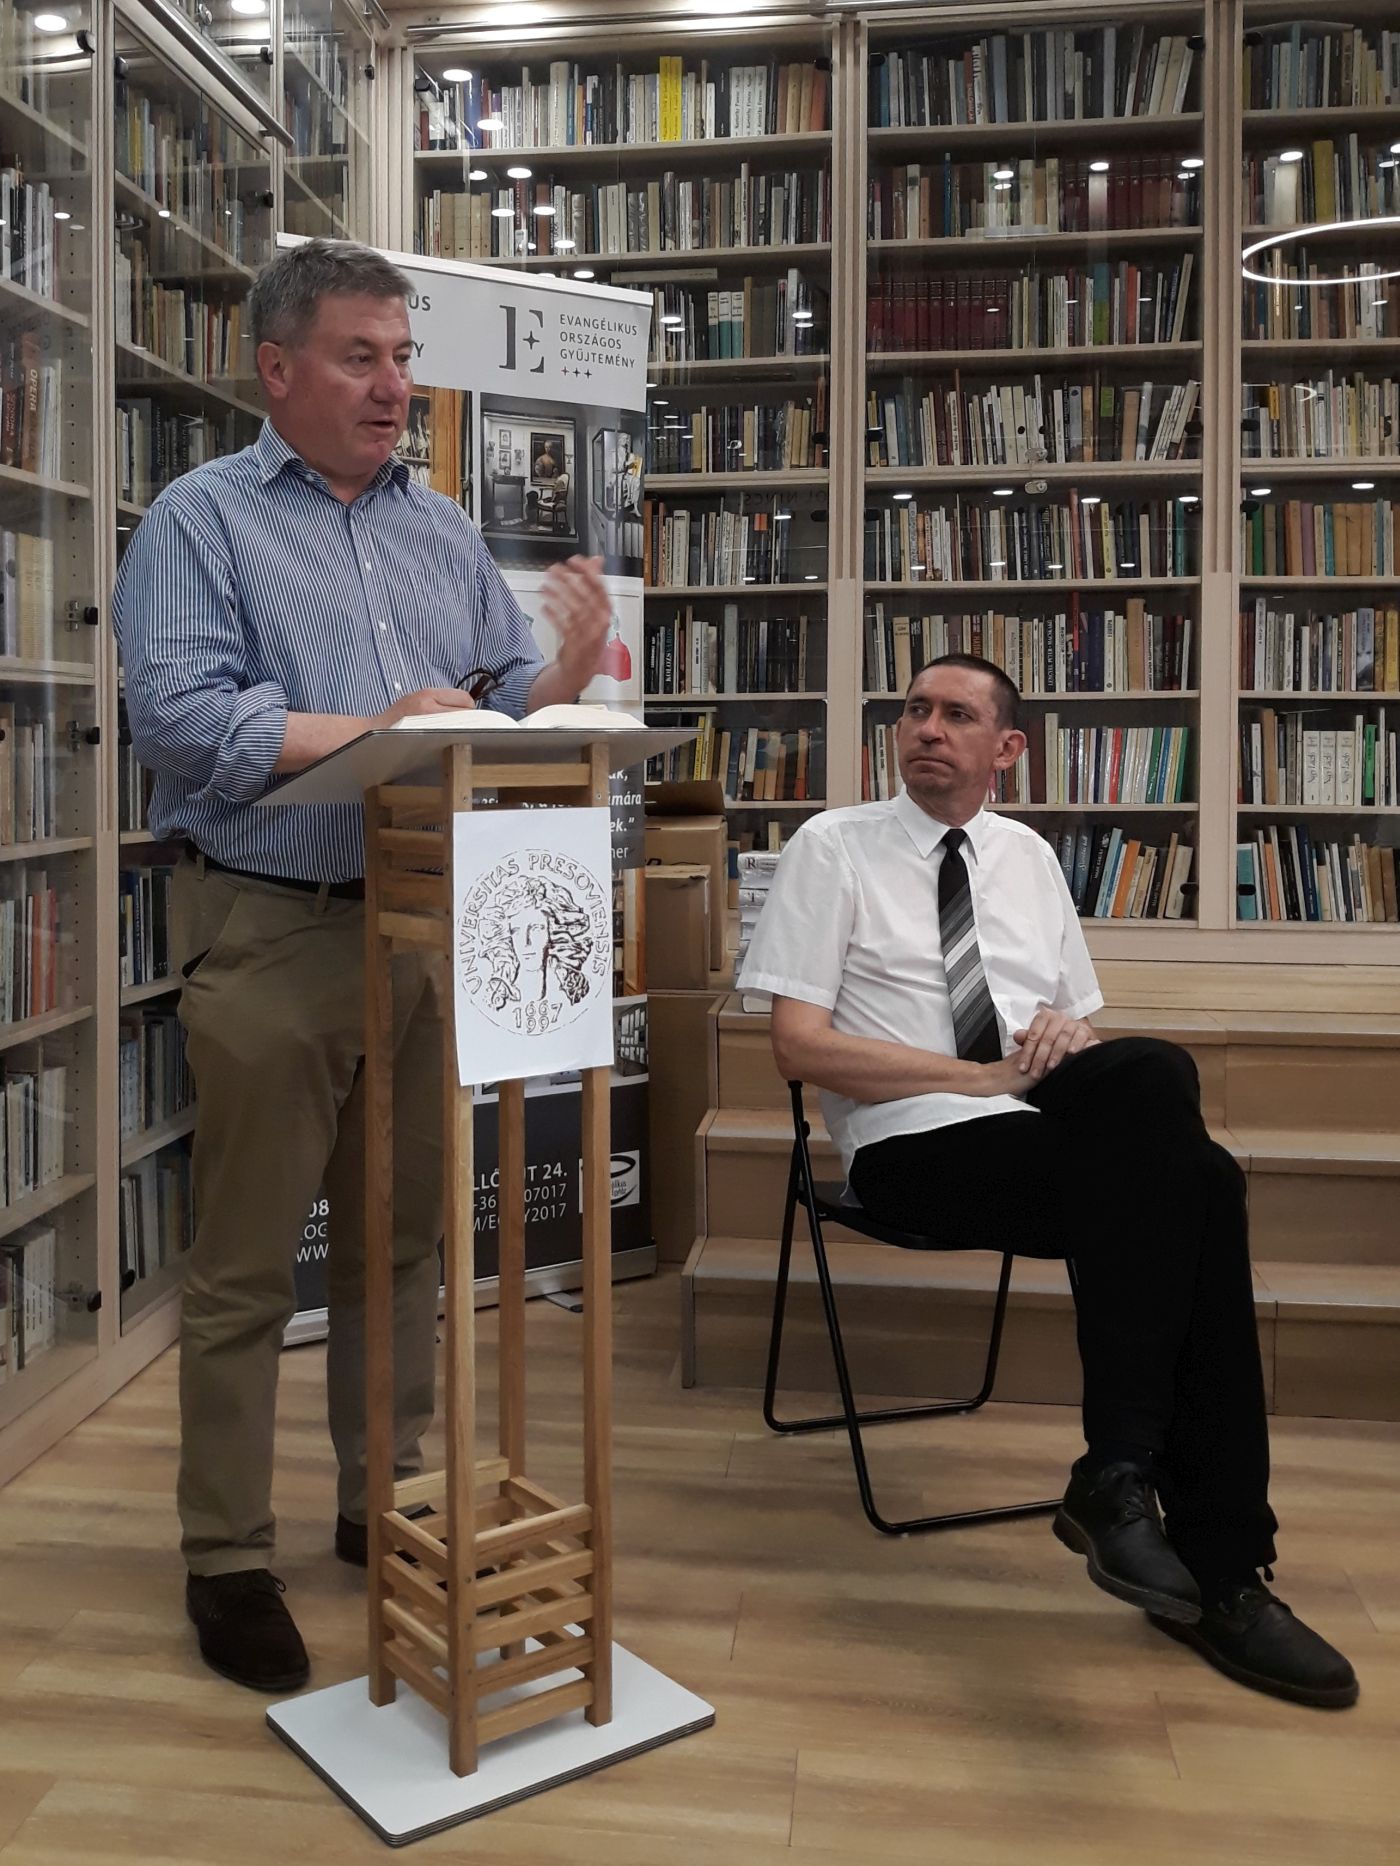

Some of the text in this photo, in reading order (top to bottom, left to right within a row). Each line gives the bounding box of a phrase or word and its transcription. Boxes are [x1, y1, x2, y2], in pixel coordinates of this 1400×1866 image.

[560, 314, 638, 336] EVANGÉLIKUS
[560, 331, 622, 349] ORSZÁGOS
[560, 348, 635, 368] GYŰJTEMÉNY
[459, 857, 520, 995] UNIVERSITAS
[542, 1162, 568, 1180] 24.
[523, 1183, 567, 1203] 07017
